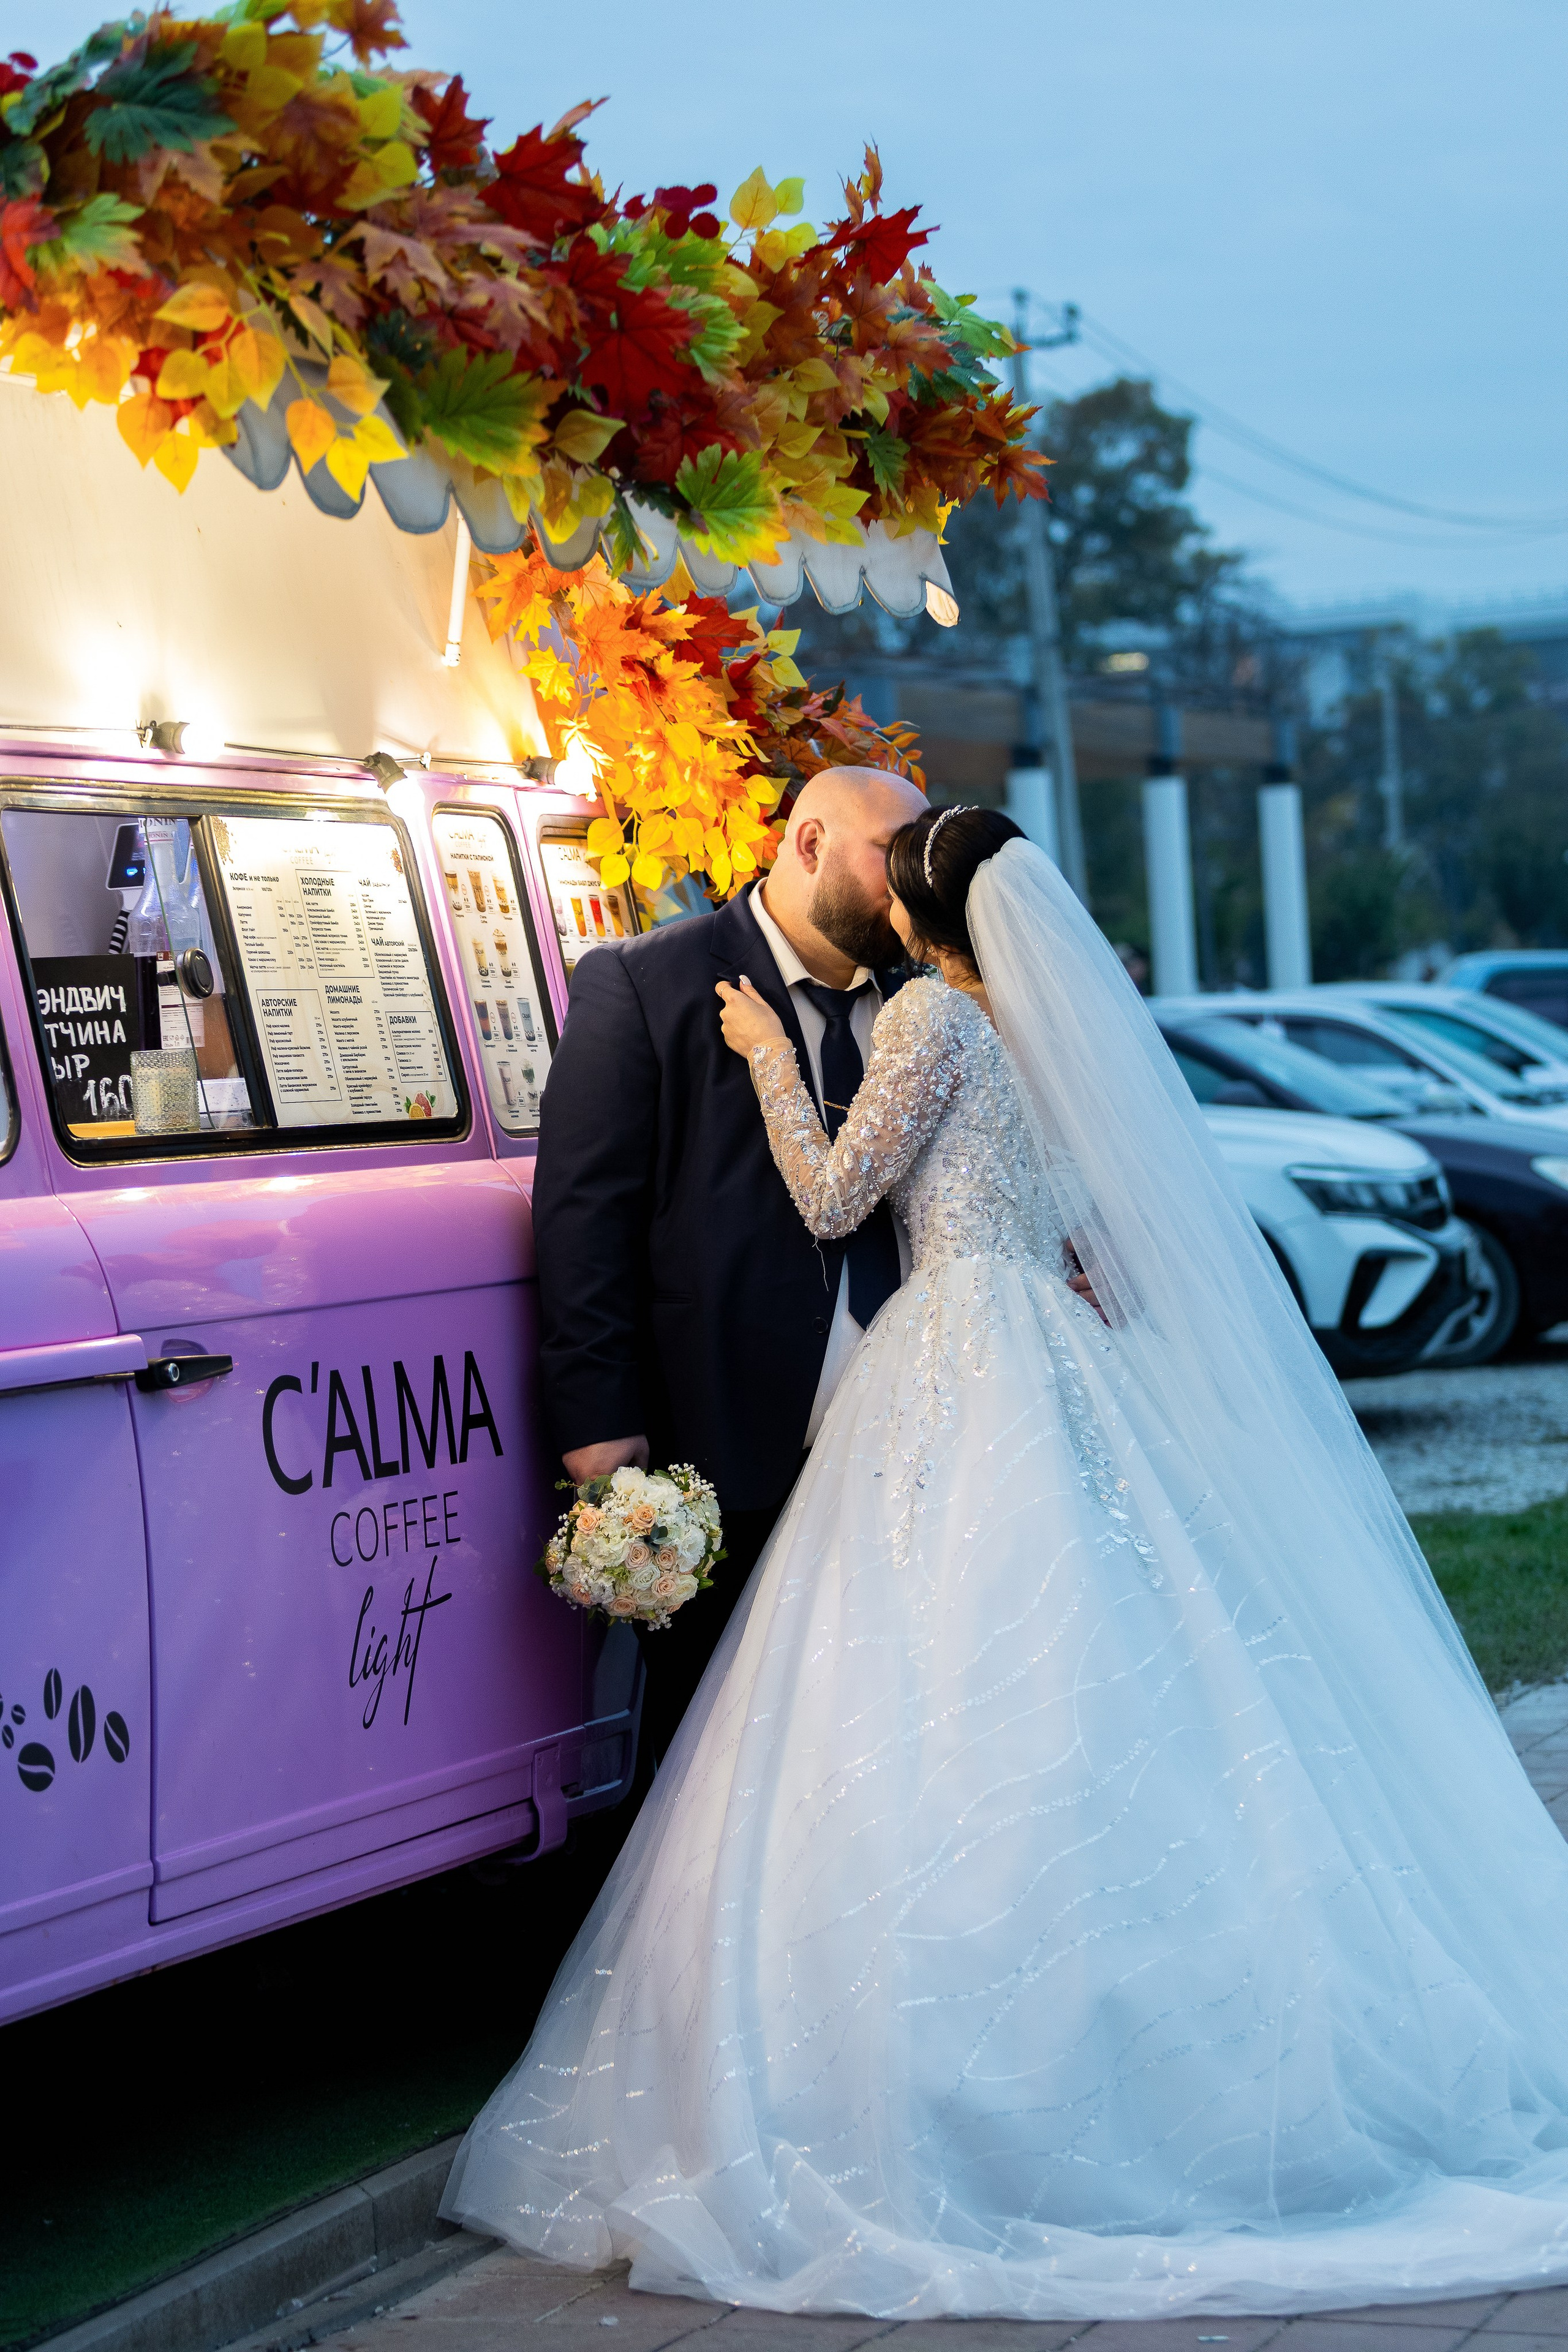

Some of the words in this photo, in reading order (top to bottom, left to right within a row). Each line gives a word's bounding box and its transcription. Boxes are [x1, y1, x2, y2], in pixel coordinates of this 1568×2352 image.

[230, 873, 248, 881] КОФЕ
[300, 877, 335, 887] ХОЛОДНЫЕ
[358, 878, 371, 887] ЧАЙ
[303, 888, 332, 896] НАПИТКИ
[371, 937, 384, 946] ЧАЙ
[325, 985, 360, 994] ДОМАШНИЕ
[37, 985, 127, 1016] ЭНДВИЧ
[262, 998, 298, 1007] АВТОРСКИЕ
[327, 996, 363, 1005] ЛИМОНАДЫ
[263, 1008, 293, 1017] НАПИТКИ
[389, 1016, 417, 1025] ДОБАВКИ
[43, 1019, 127, 1049] ТЧИНА
[83, 1074, 134, 1116] 160
[262, 1349, 504, 1496] C'ALMA
[330, 1490, 461, 1567] COFFEE
[349, 1555, 453, 1730] light
